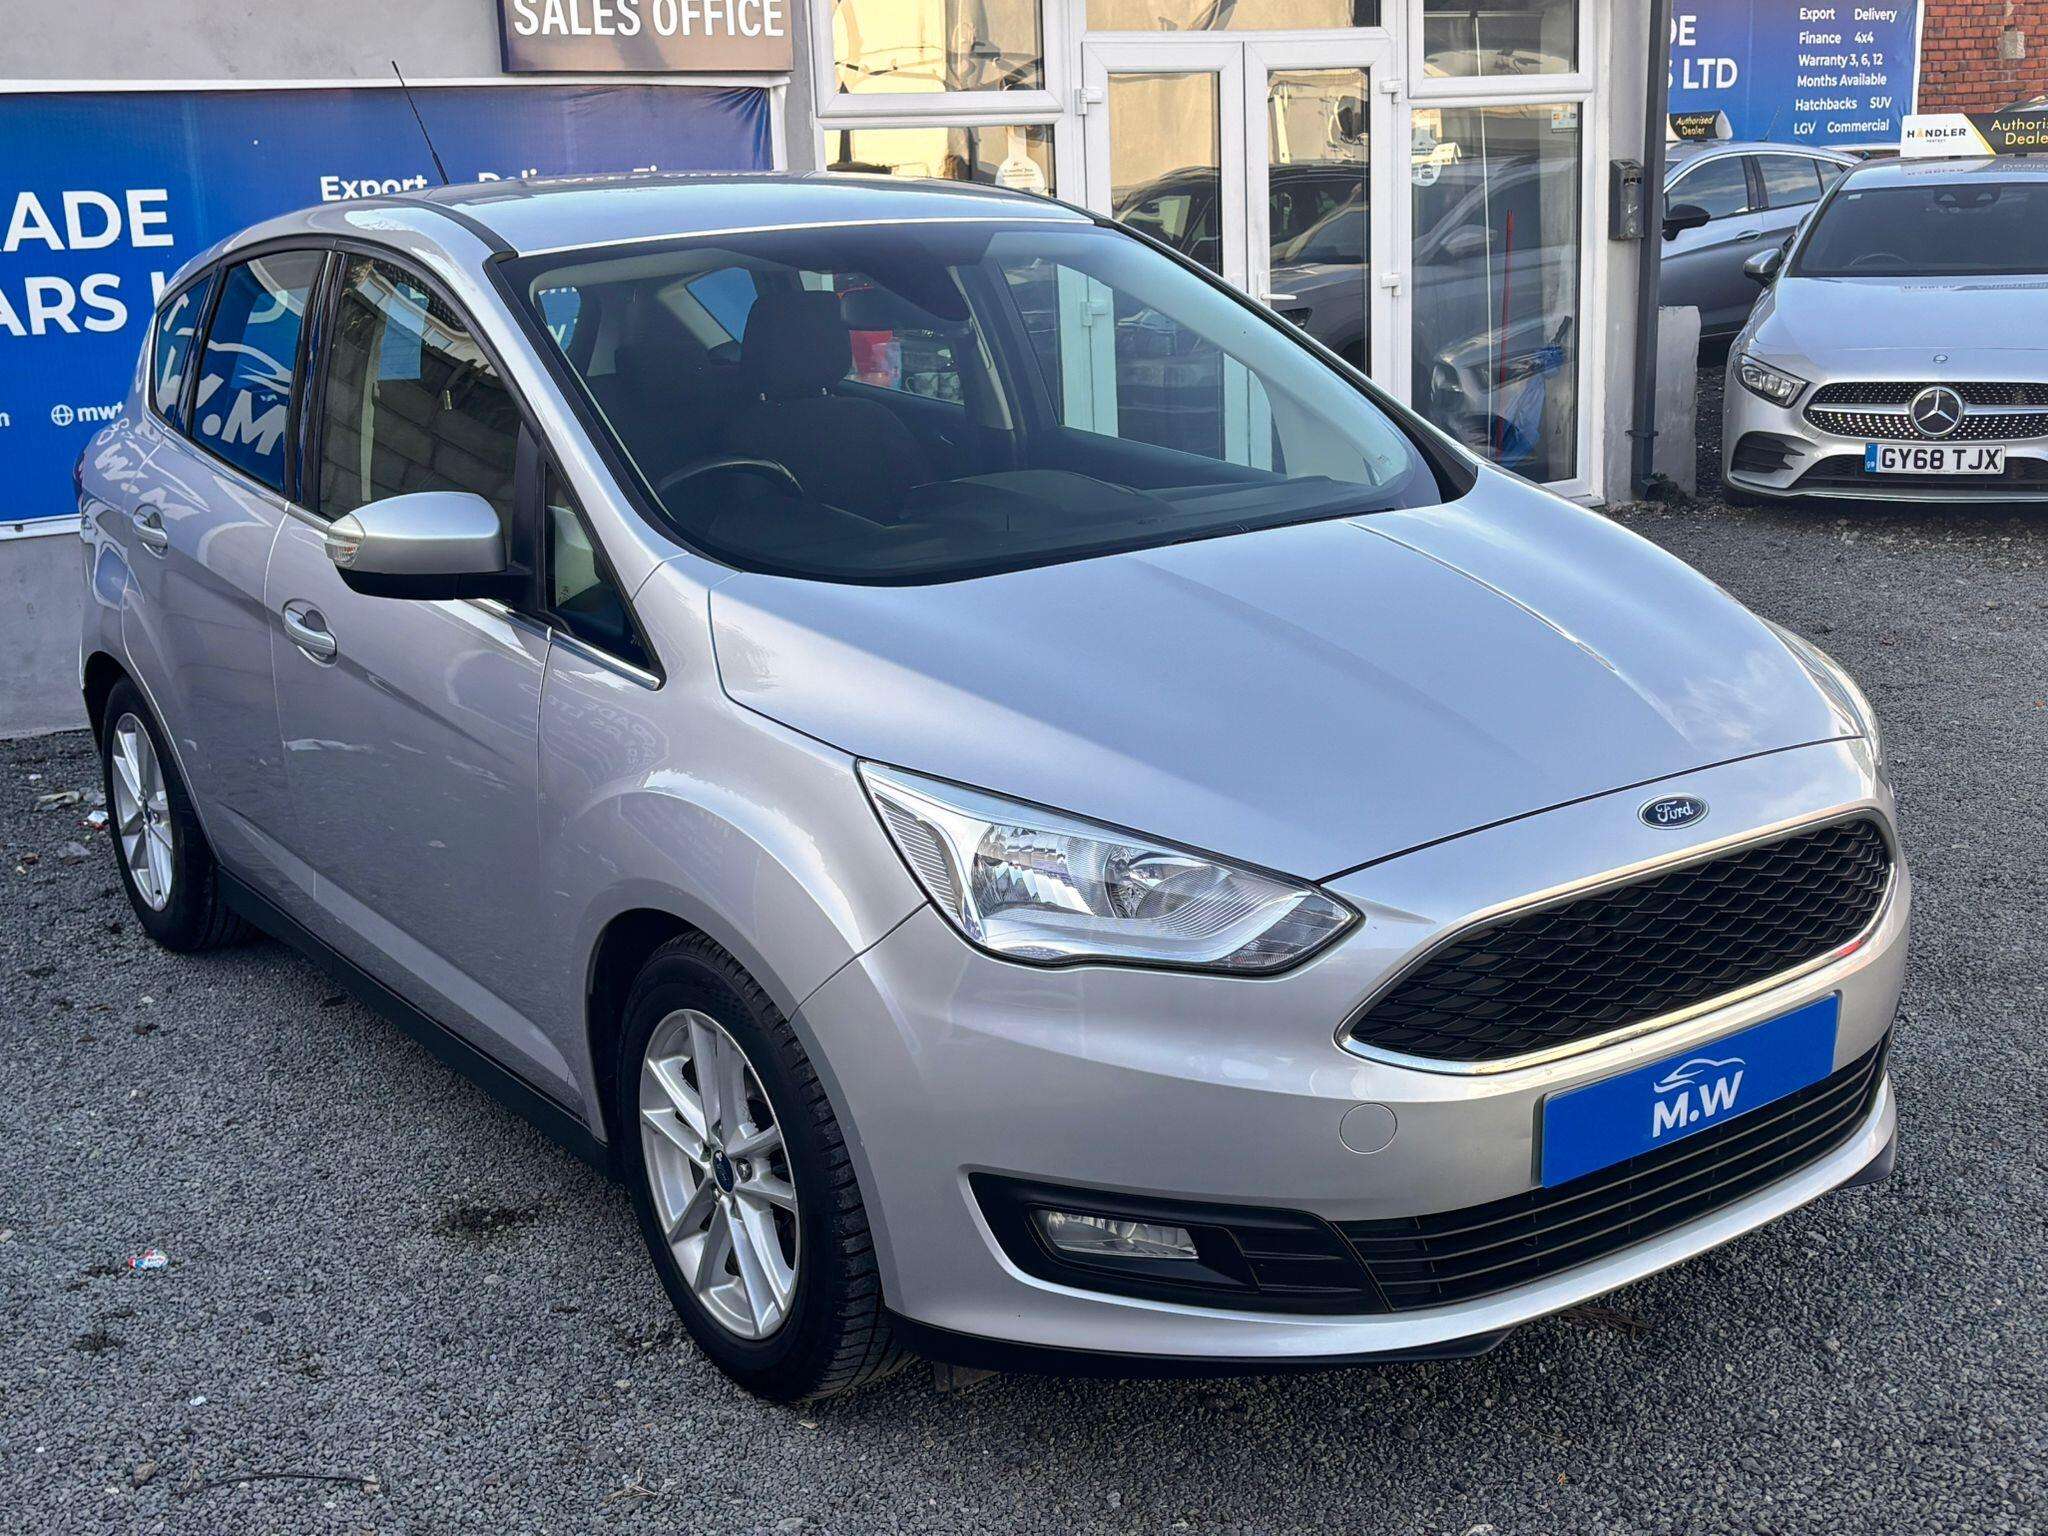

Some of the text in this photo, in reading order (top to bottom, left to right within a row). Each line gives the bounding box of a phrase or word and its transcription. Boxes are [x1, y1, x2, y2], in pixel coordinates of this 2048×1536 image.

[514, 0, 784, 36] SALES OFFICE
[1800, 7, 1898, 23] Export Delivery
[1799, 30, 1874, 45] Finance 4x4
[1798, 53, 1883, 69] Warranty 3, 6, 12
[1683, 58, 1738, 89] LTD
[1797, 72, 1887, 87] Months Available
[1795, 96, 1892, 111] Hatchbacks SUV
[1676, 115, 1715, 126] Authorised
[1794, 119, 1890, 135] LGV Commercial
[1990, 118, 2048, 131] Authori
[1682, 126, 1706, 136] Dealer
[0, 189, 174, 252] ADE
[1881, 448, 2002, 470] GY68 TJX
[1655, 800, 1694, 823] Ford
[1652, 1070, 1744, 1138] M.W
